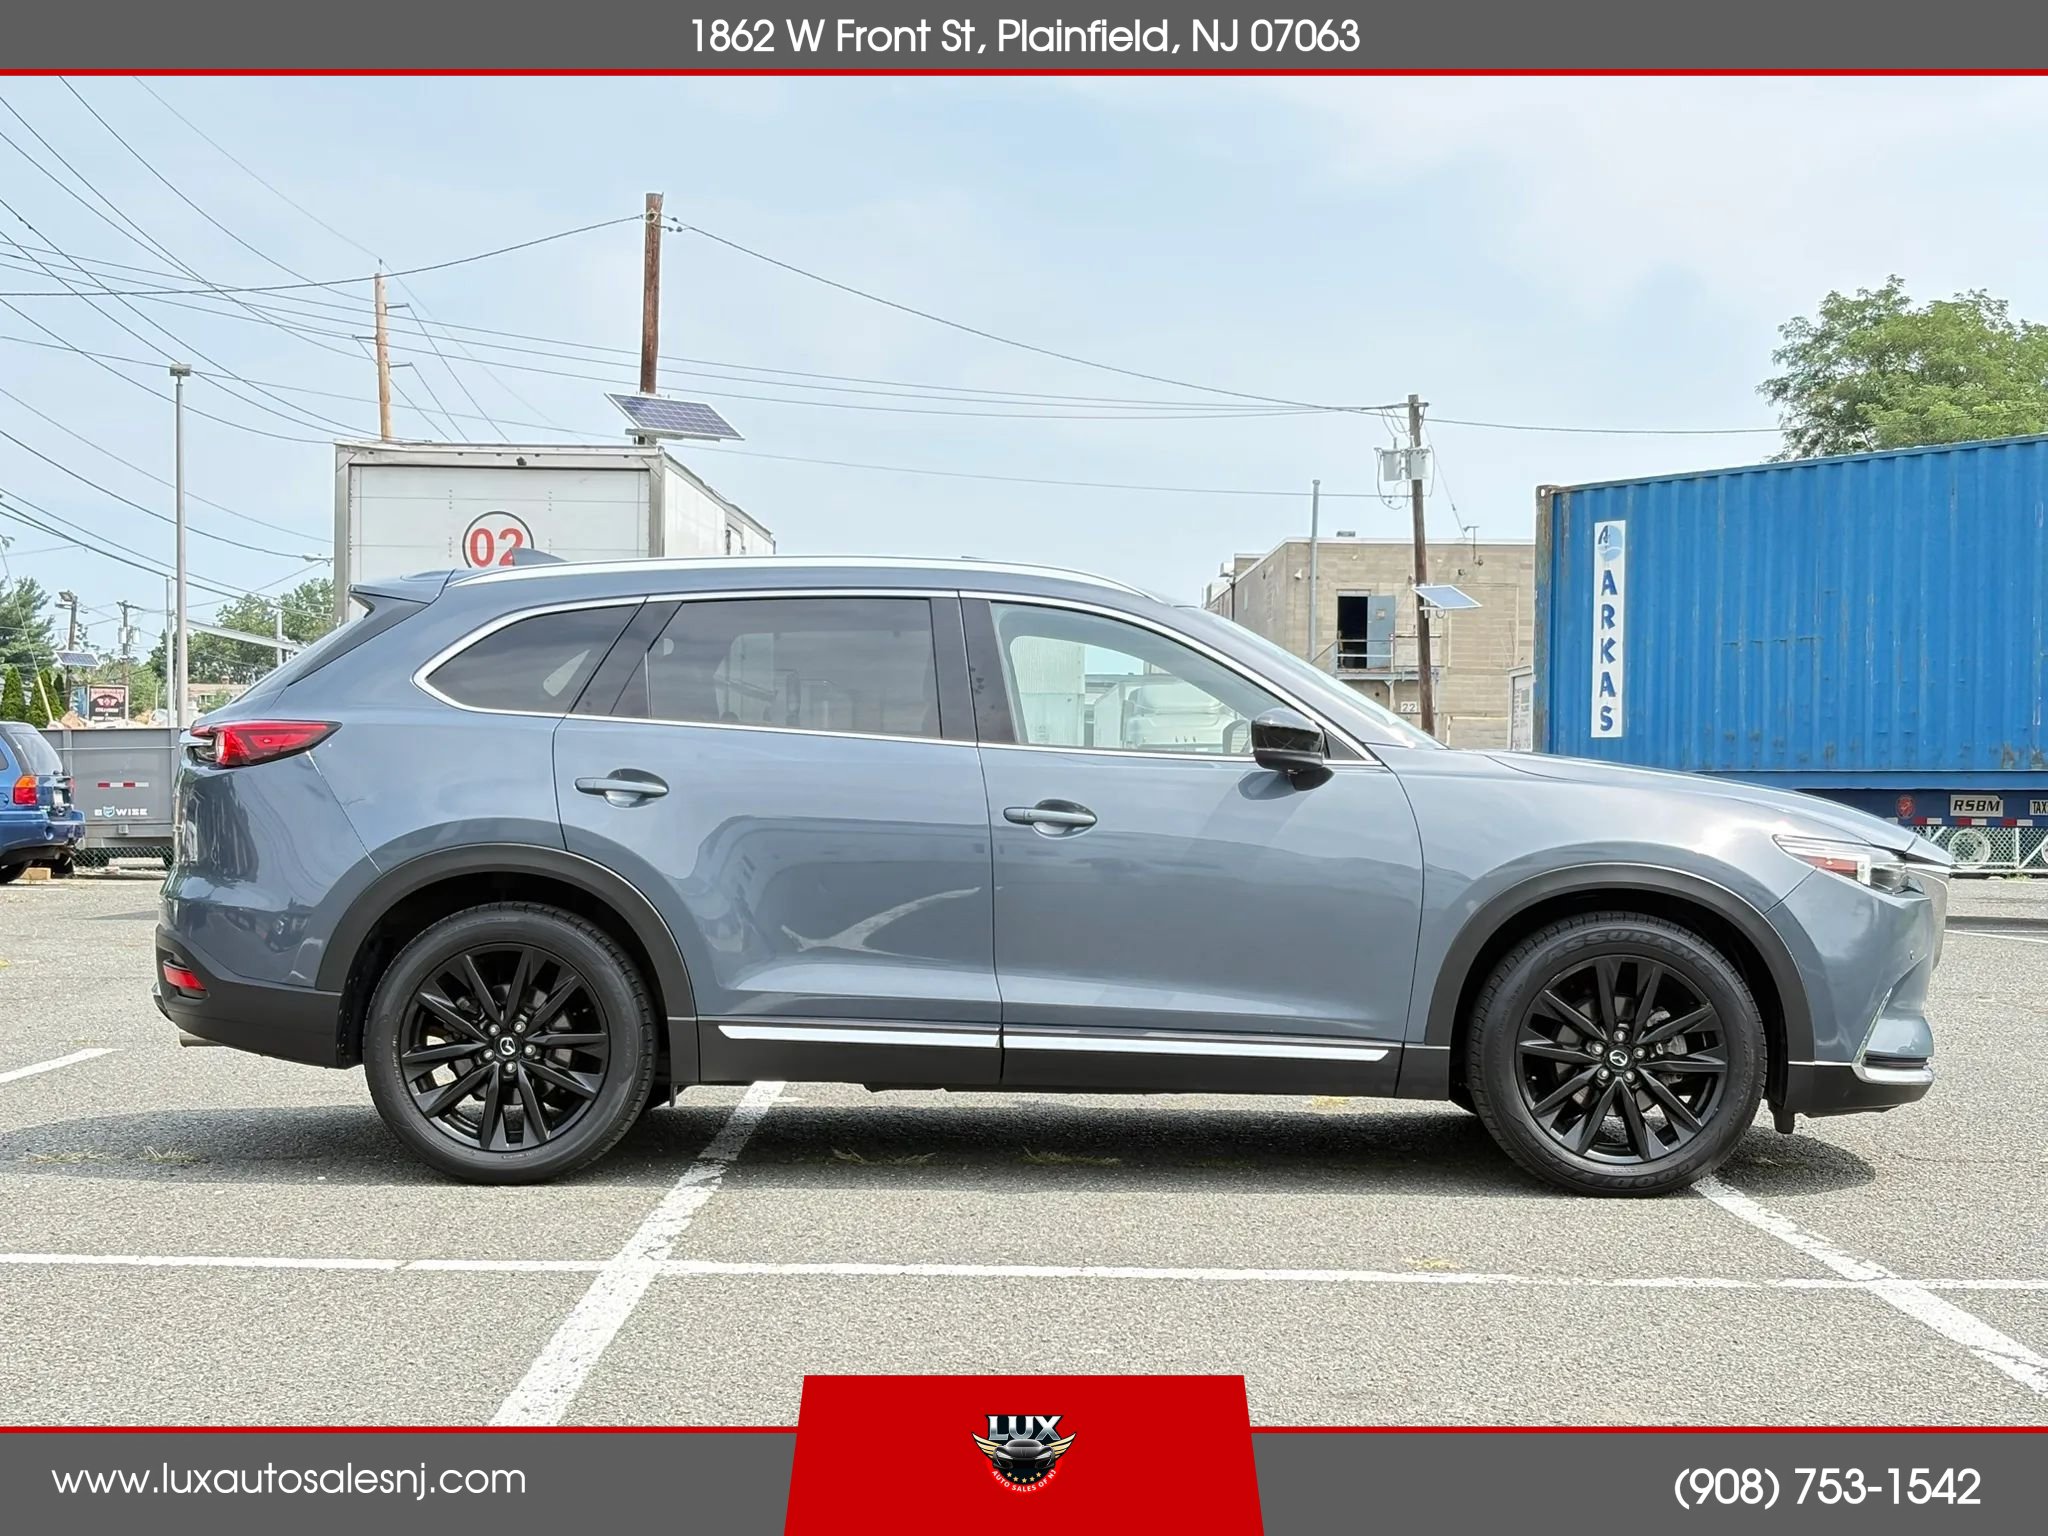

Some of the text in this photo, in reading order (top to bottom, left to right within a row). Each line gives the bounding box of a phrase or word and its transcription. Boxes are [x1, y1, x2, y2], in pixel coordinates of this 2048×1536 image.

[470, 528, 523, 567] 02
[1600, 569, 1618, 731] ARKAS
[1402, 703, 1416, 712] 22
[1953, 799, 2000, 811] RSBM
[2032, 801, 2047, 814] TAX
